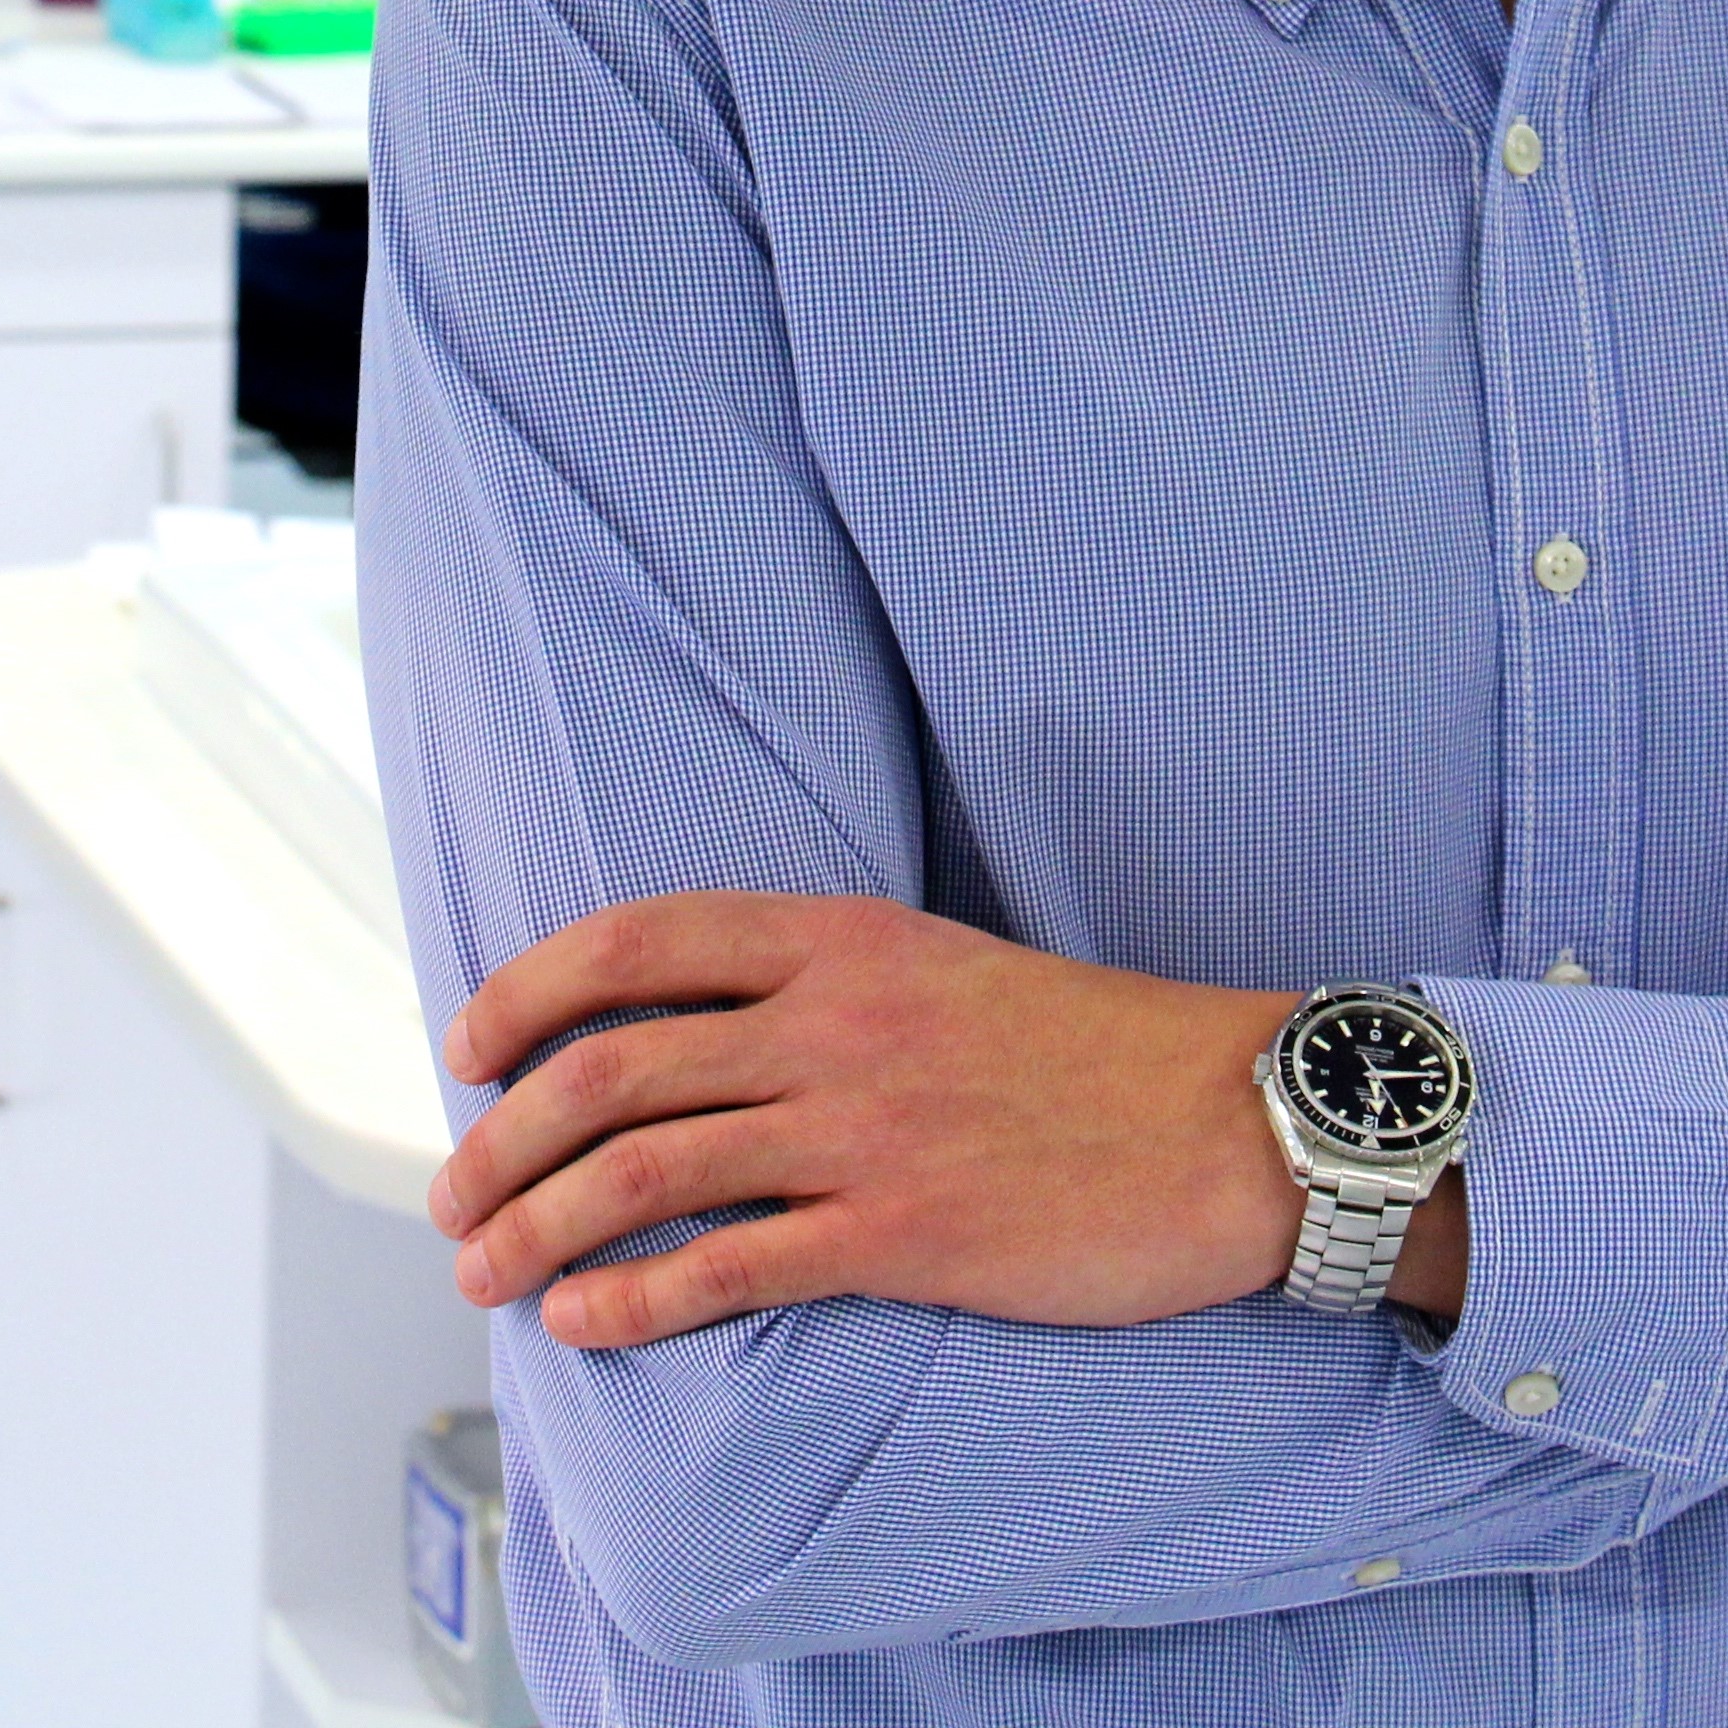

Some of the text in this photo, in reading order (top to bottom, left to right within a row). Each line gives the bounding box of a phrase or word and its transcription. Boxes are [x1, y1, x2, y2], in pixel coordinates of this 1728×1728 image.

[1445, 1034, 1464, 1060] 40
[1362, 1114, 1379, 1130] 12
[1439, 1107, 1462, 1131] 50
